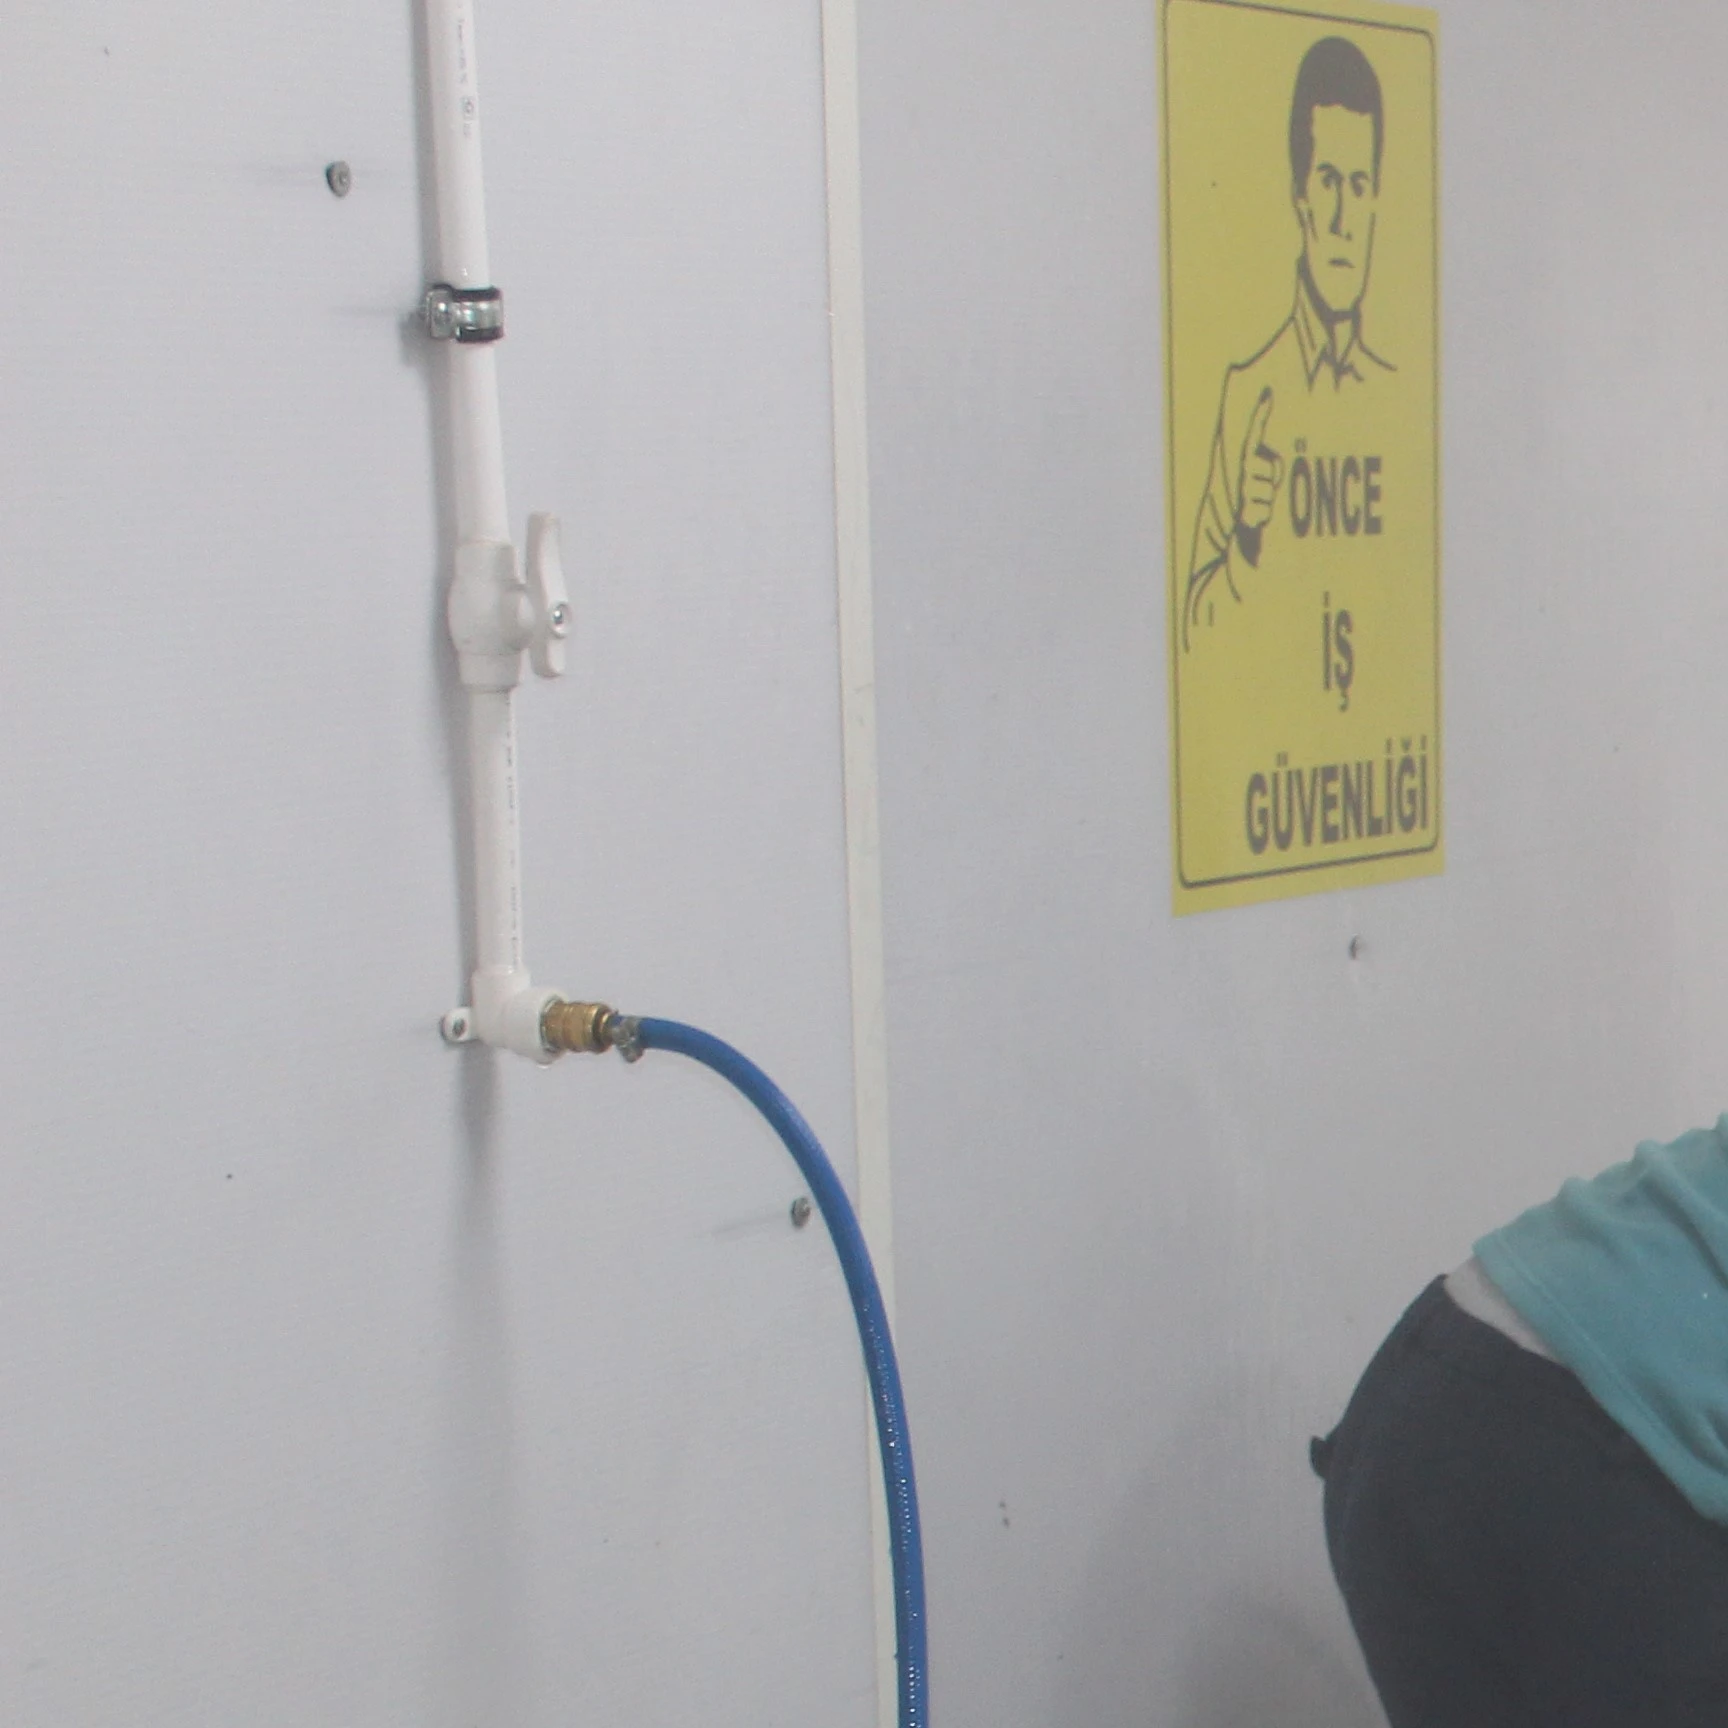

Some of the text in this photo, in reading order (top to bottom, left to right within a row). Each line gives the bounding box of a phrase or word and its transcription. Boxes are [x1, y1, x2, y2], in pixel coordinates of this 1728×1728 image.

[1288, 437, 1383, 538] ÖNCE
[1321, 591, 1354, 712] İŞ
[1244, 734, 1428, 855] GÜVENLİĞİ
